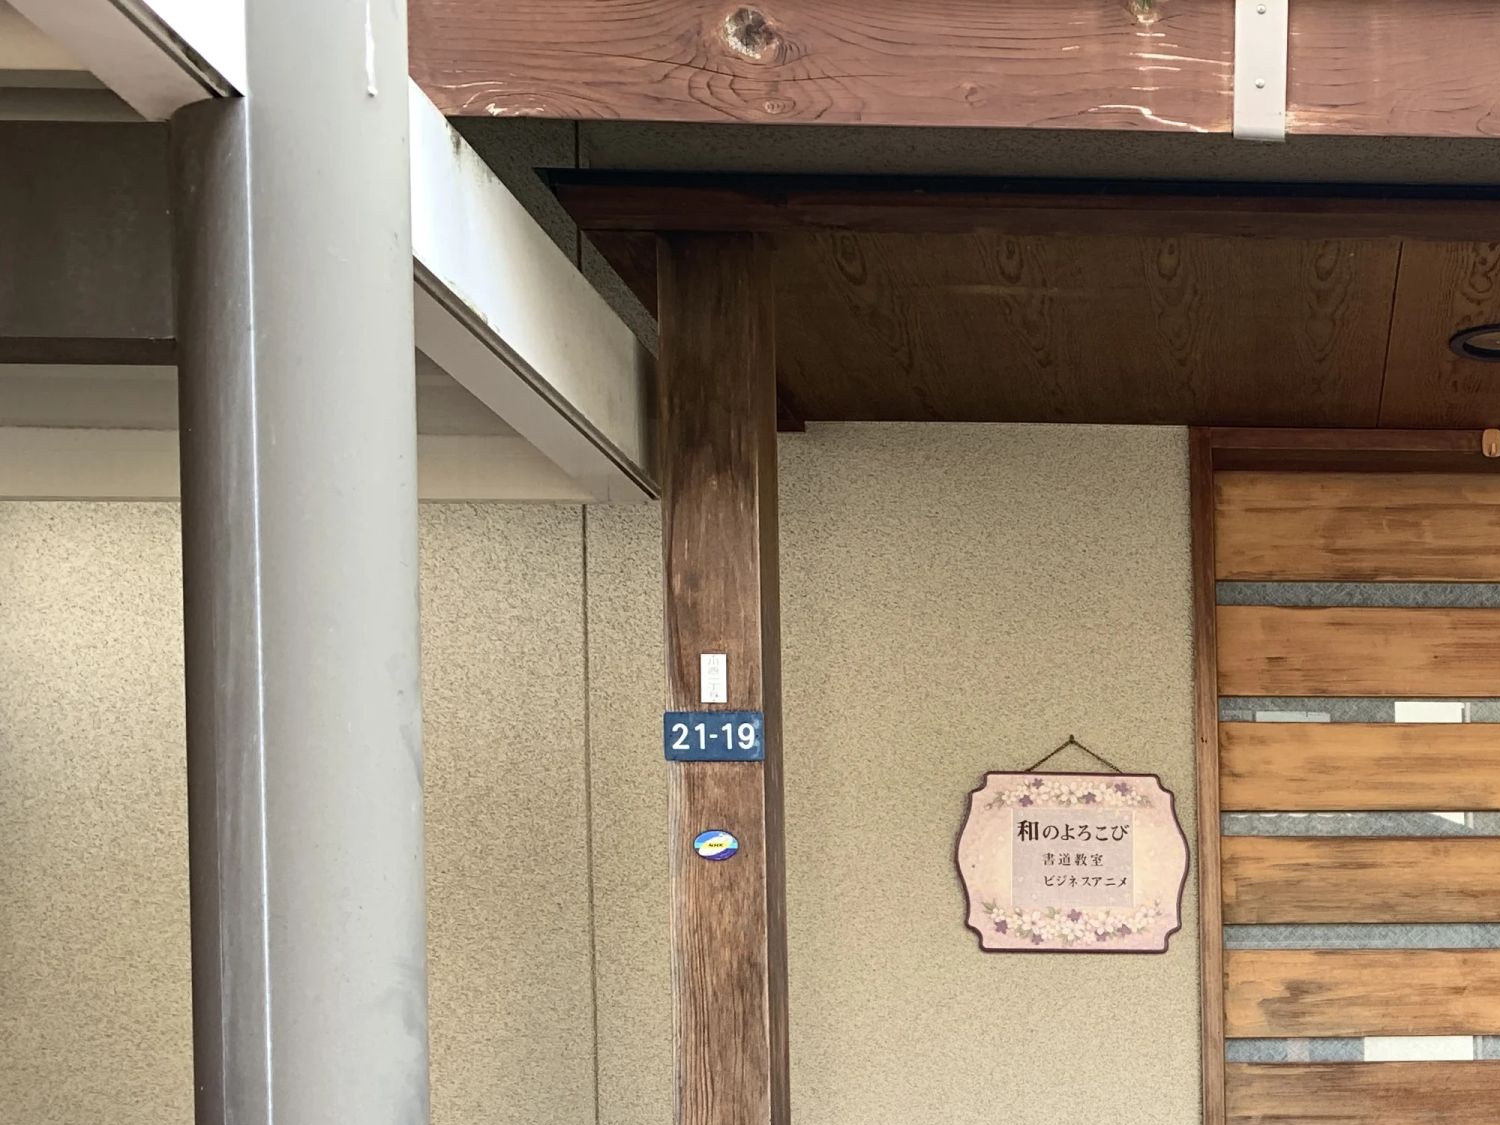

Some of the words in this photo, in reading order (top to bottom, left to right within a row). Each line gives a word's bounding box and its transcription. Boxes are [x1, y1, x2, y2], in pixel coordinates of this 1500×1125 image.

[671, 722, 756, 751] 21-19
[1016, 819, 1129, 842] 和のよろこび
[1042, 852, 1105, 867] 書道教室
[1043, 874, 1128, 888] ビジネスアニメ
